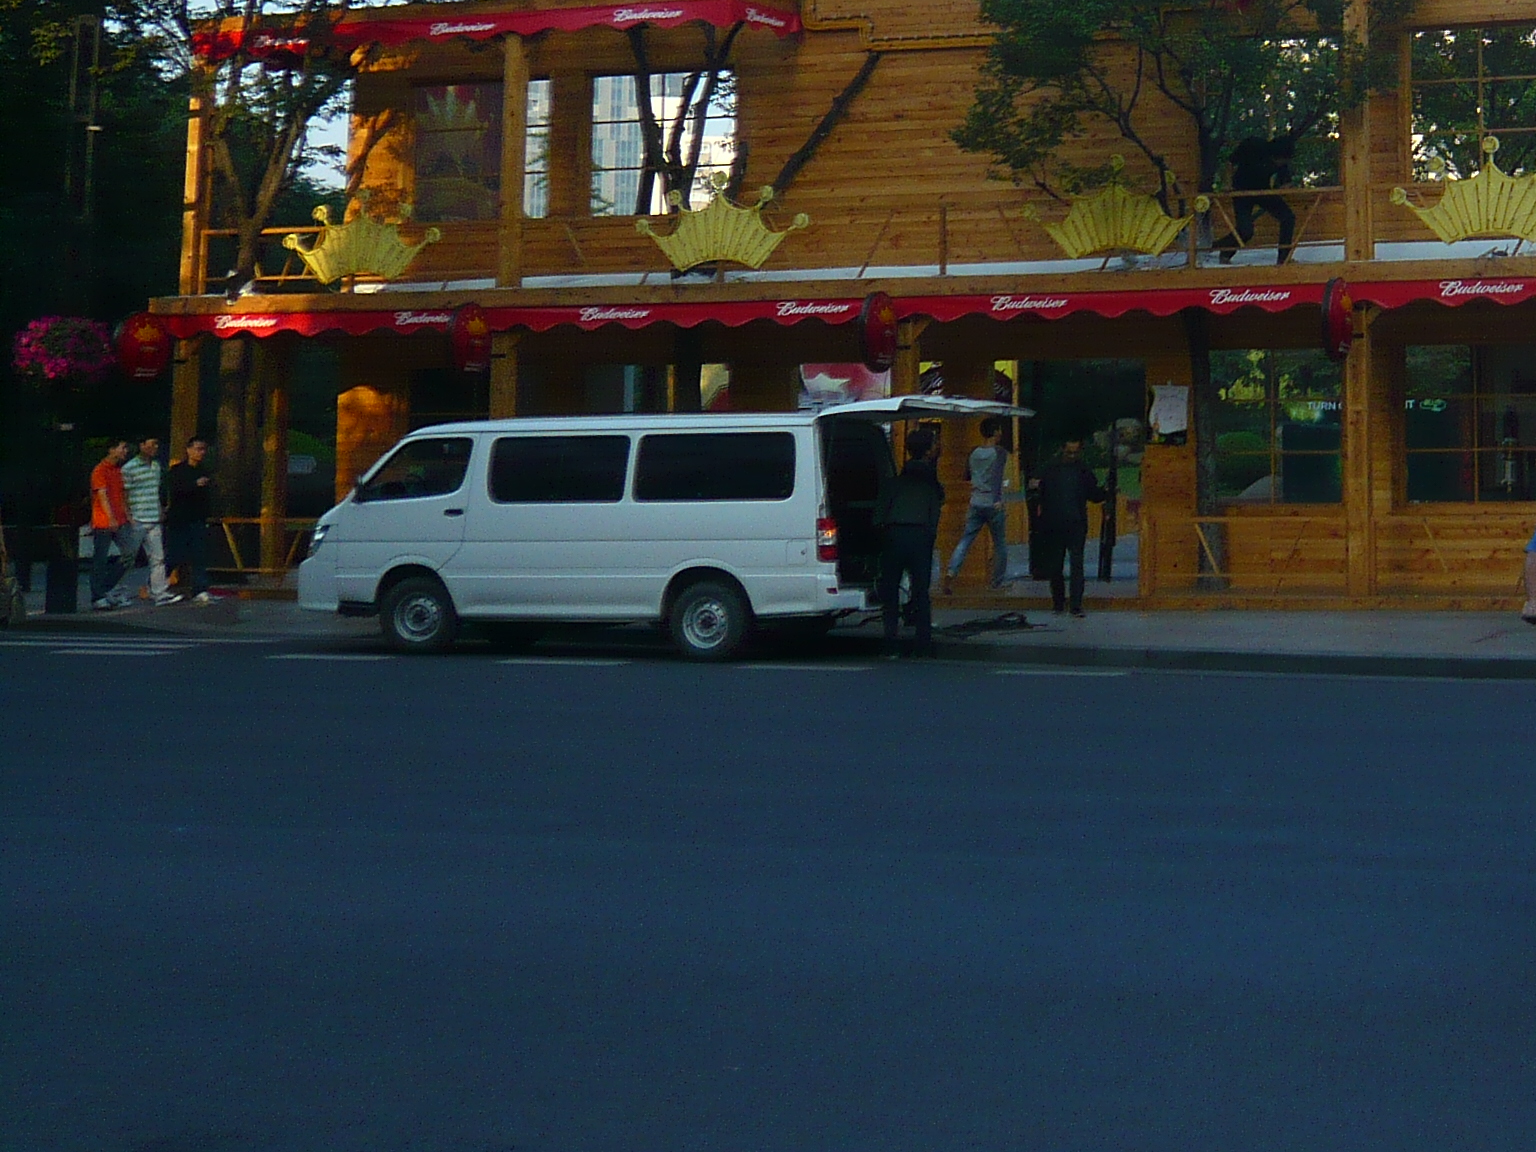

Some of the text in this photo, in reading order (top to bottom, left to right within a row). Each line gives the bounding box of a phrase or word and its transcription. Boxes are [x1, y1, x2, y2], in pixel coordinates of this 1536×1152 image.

[614, 7, 682, 23] Budweiser
[430, 21, 497, 36] Budweiser
[1209, 288, 1290, 305] Budweiser
[1438, 280, 1523, 297] Budweiser
[776, 301, 849, 317] Budweiser
[990, 294, 1067, 311] Budweiser
[580, 305, 649, 321] Budweiser
